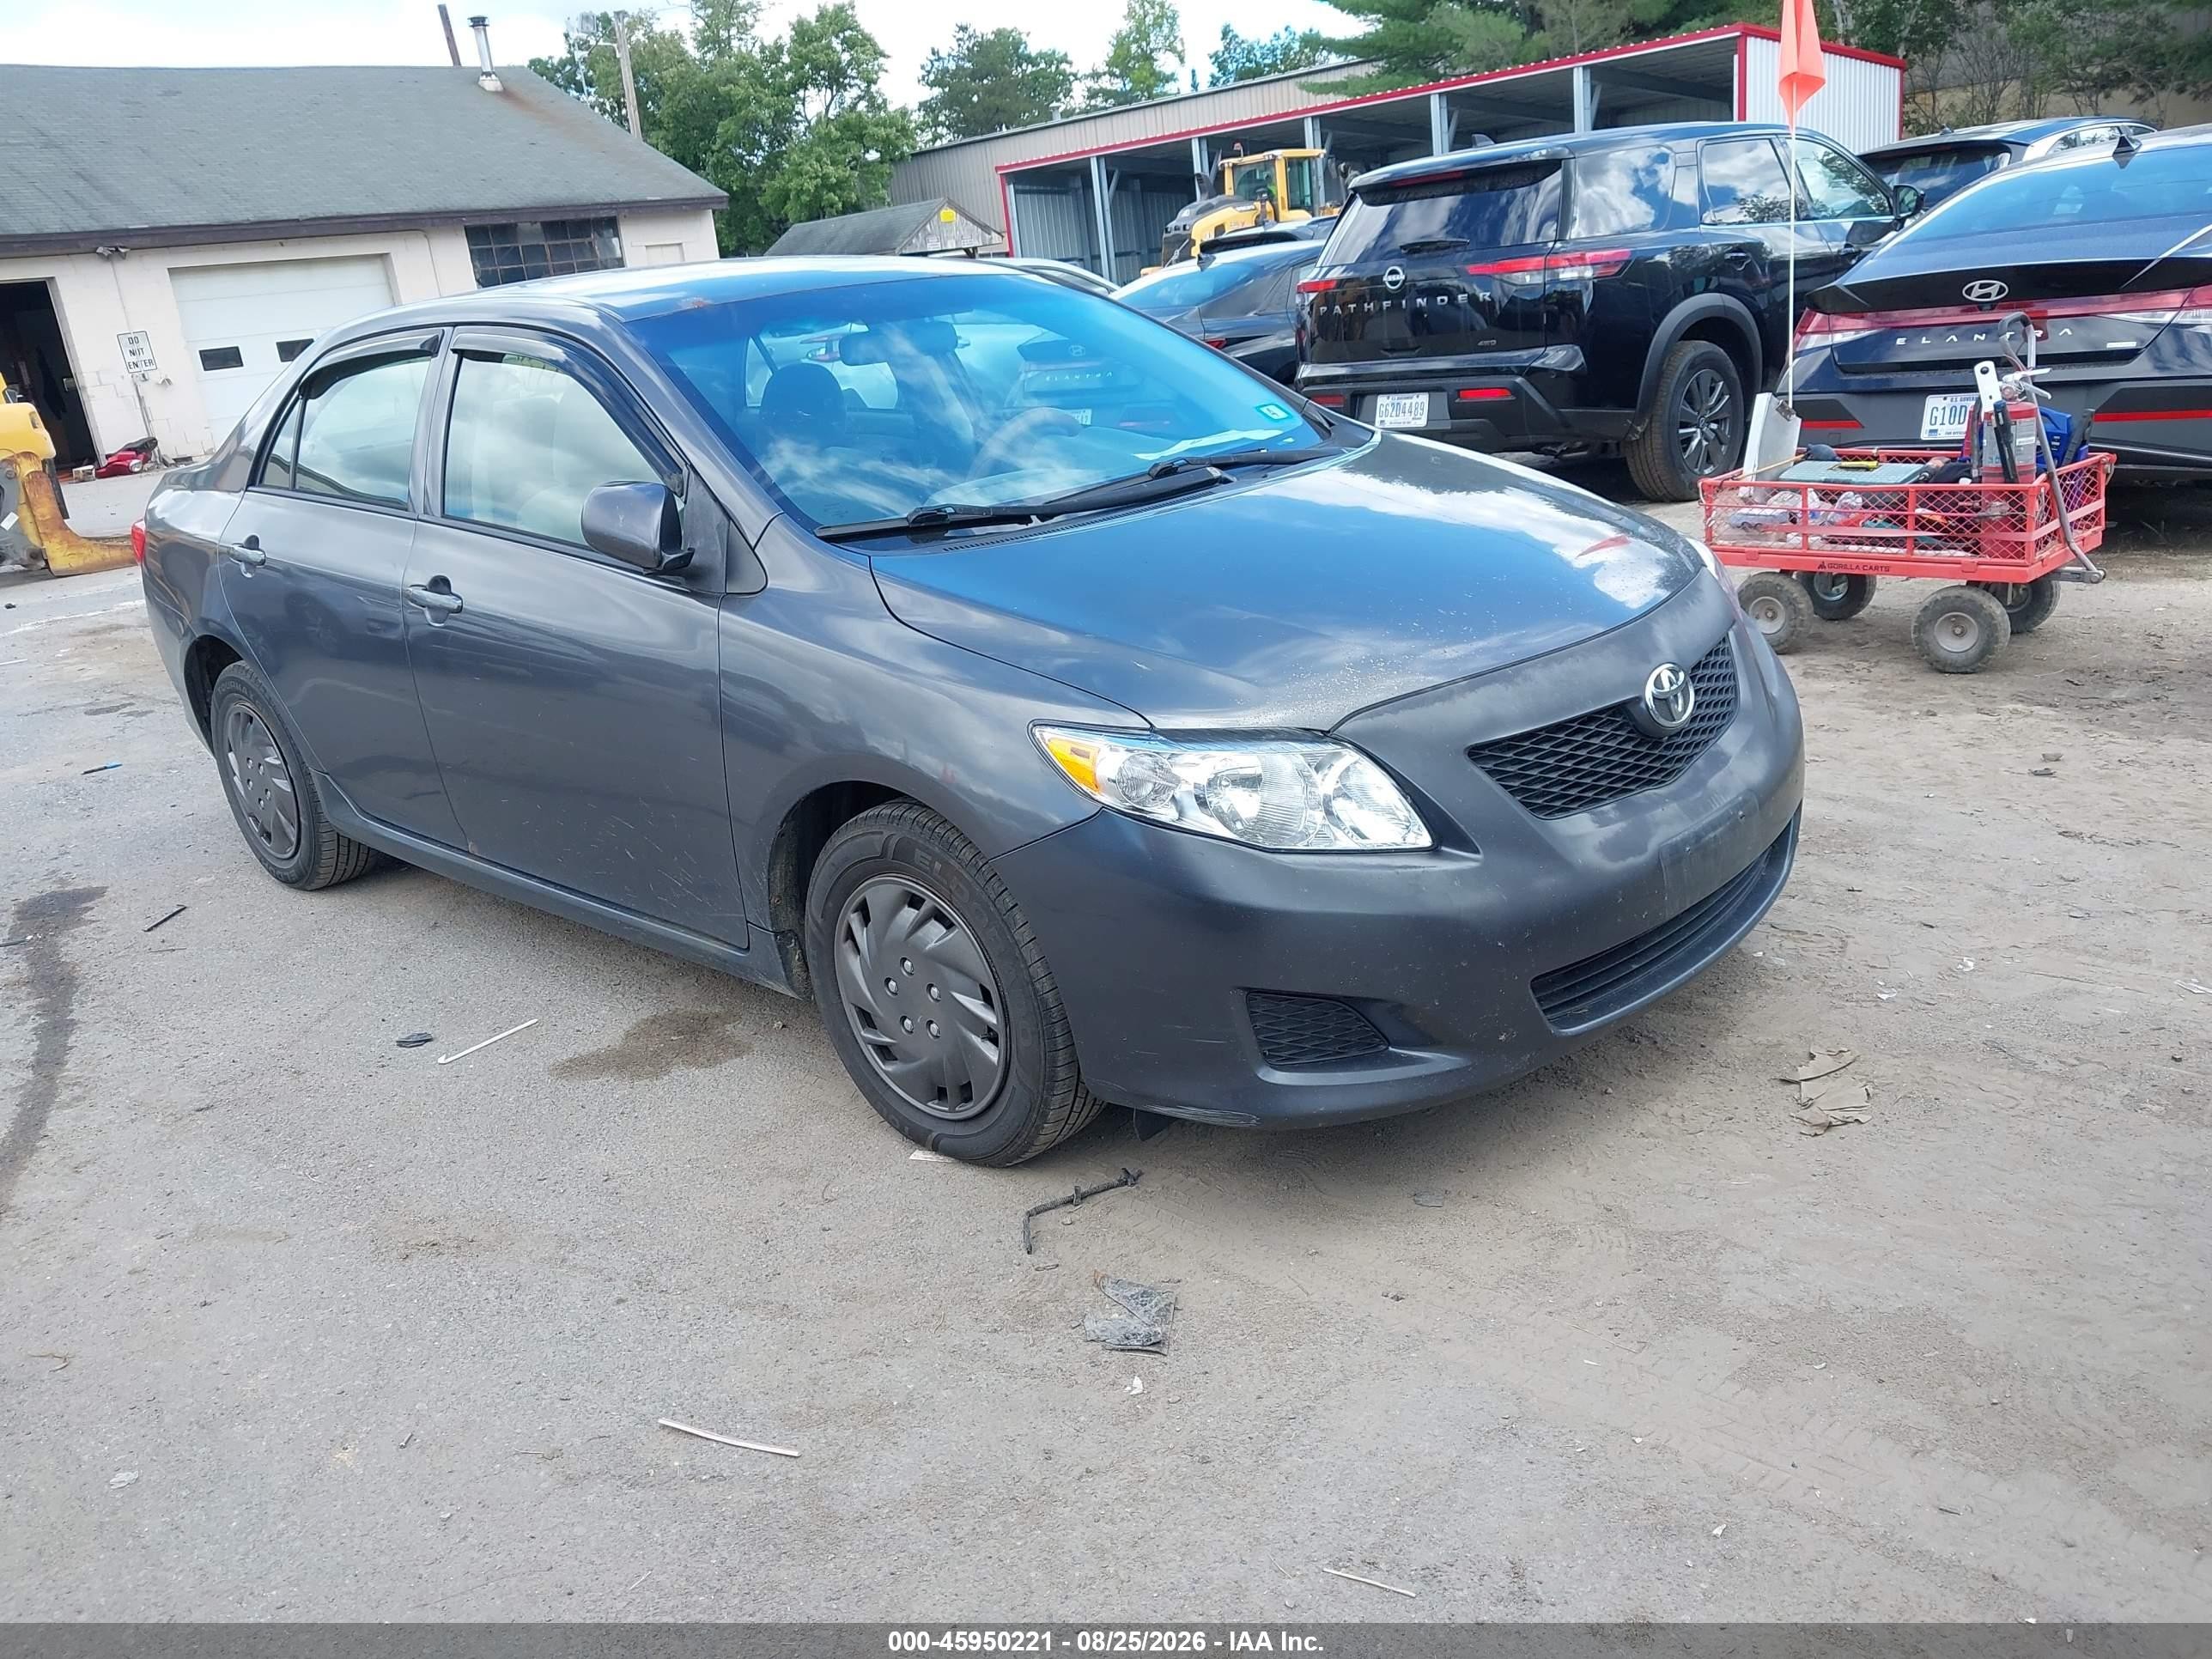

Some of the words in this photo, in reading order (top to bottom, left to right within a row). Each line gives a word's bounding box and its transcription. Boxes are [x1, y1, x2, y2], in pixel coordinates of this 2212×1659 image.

[1319, 291, 1492, 316] PATHFINDER
[128, 336, 140, 345] DO
[1895, 327, 2073, 345] ELANTRA
[128, 358, 155, 370] ENTER
[1378, 401, 1425, 418] G62D4489
[1929, 404, 1968, 426] G10D
